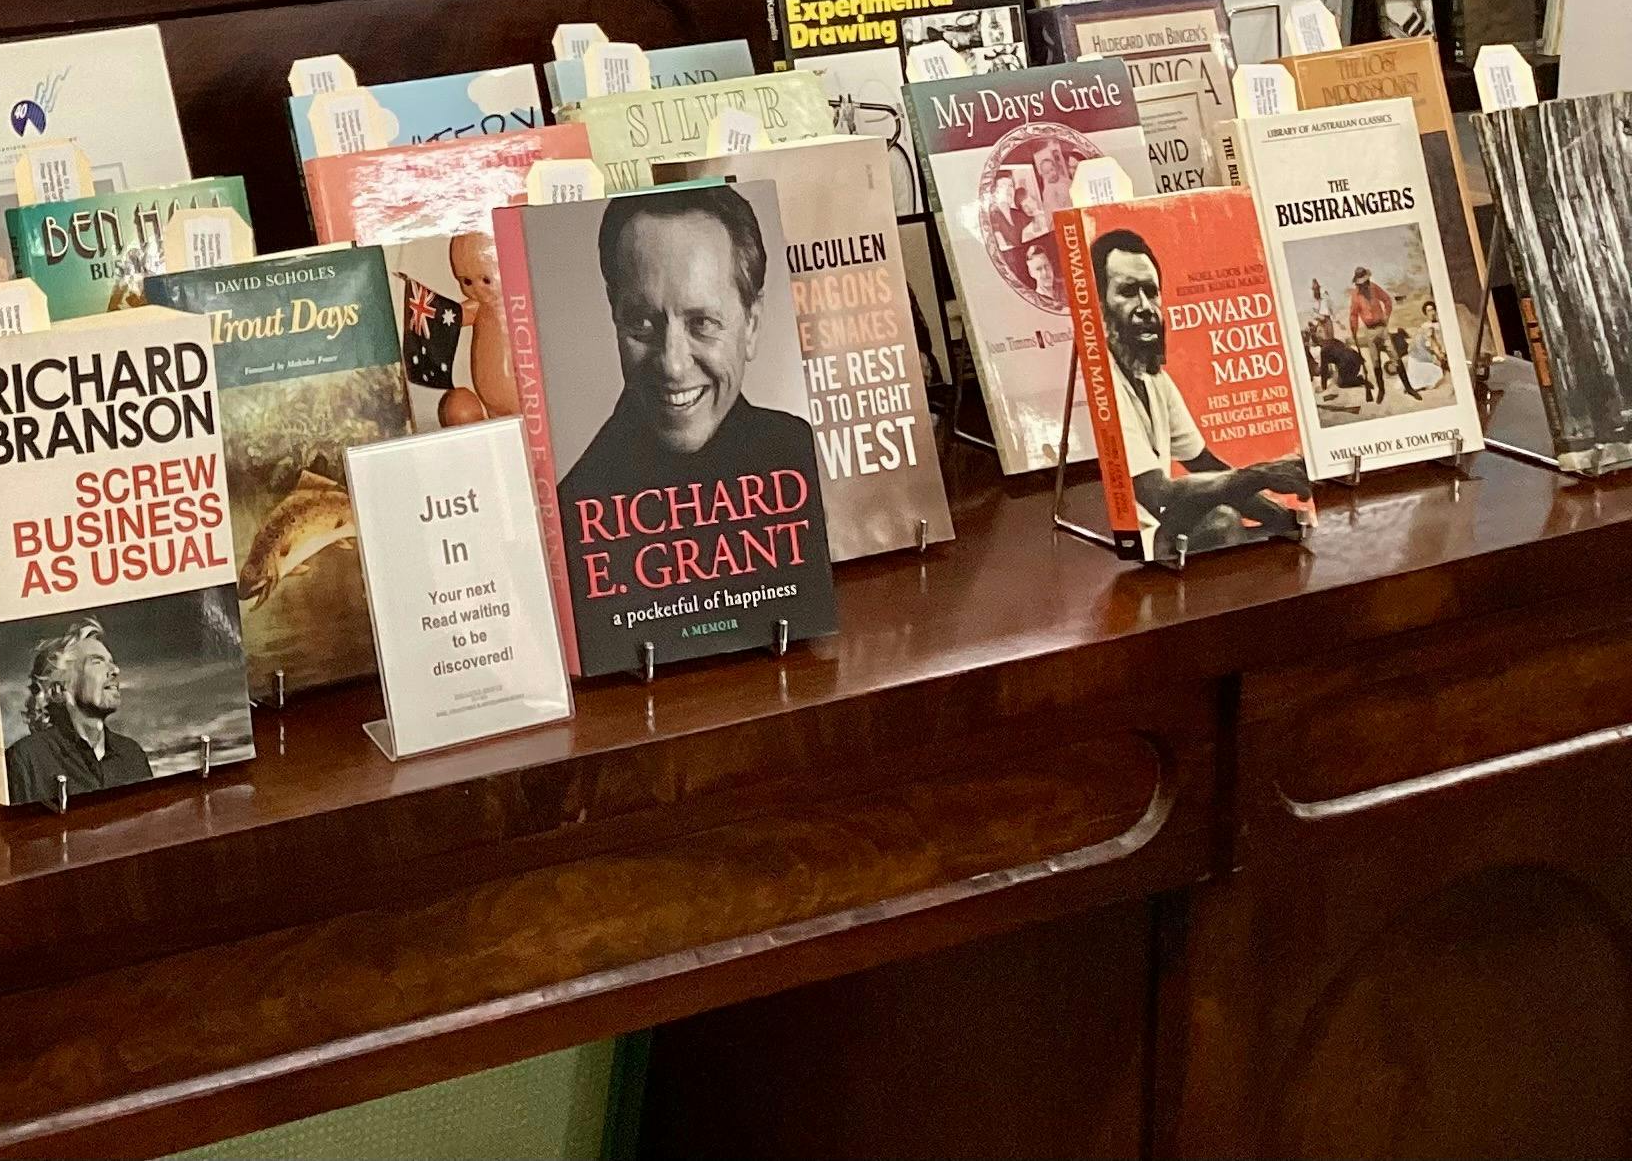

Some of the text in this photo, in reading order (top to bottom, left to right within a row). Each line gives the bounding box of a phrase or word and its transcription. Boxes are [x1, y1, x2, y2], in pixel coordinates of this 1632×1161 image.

[788, 14, 897, 50] Drawing
[14, 103, 28, 119] 40
[930, 94, 975, 138] My
[1050, 75, 1122, 113] Circle
[1267, 114, 1393, 139] LIBRARY OF AUSTRALIAN CLASSICS
[1223, 136, 1236, 160] THE
[1328, 179, 1350, 194] THE
[1275, 187, 1415, 227] BUSHRANGERS
[43, 207, 124, 265] BEN
[215, 265, 336, 295] DAVID SCHOLES
[210, 297, 361, 345] Trout Days
[820, 309, 899, 349] SNAKES
[1063, 224, 1111, 422] EDWARD KOIKI MABO
[1167, 293, 1273, 331] EDWARD
[1209, 322, 1280, 355] KOIKI
[509, 294, 542, 435] RICHARD
[847, 343, 906, 387] REST
[1211, 351, 1284, 385] MABO
[826, 383, 912, 423] TO FIGHT
[1200, 401, 1291, 428] STRUGGLE FOR
[1208, 385, 1288, 409] HIS LIFE AND
[1211, 418, 1294, 443] LAND RIGHTS
[1375, 440, 1393, 455] JOY
[1396, 439, 1403, 450] &
[1405, 434, 1429, 447] TOM
[816, 416, 917, 481] WEST
[75, 454, 216, 508] SCREW
[419, 488, 479, 523] Just
[574, 468, 810, 545] RICHARD
[12, 493, 224, 558] BUSINESS
[20, 532, 228, 598] AS USUAL
[443, 538, 469, 565] In
[584, 520, 810, 599] E. GRANT
[428, 579, 497, 606] Your next
[612, 581, 798, 629] a pocketful of happiness
[422, 601, 510, 631] Read waiting
[681, 618, 739, 638] A MEMOIR
[452, 630, 488, 649] to be
[433, 646, 514, 676] discovered!
